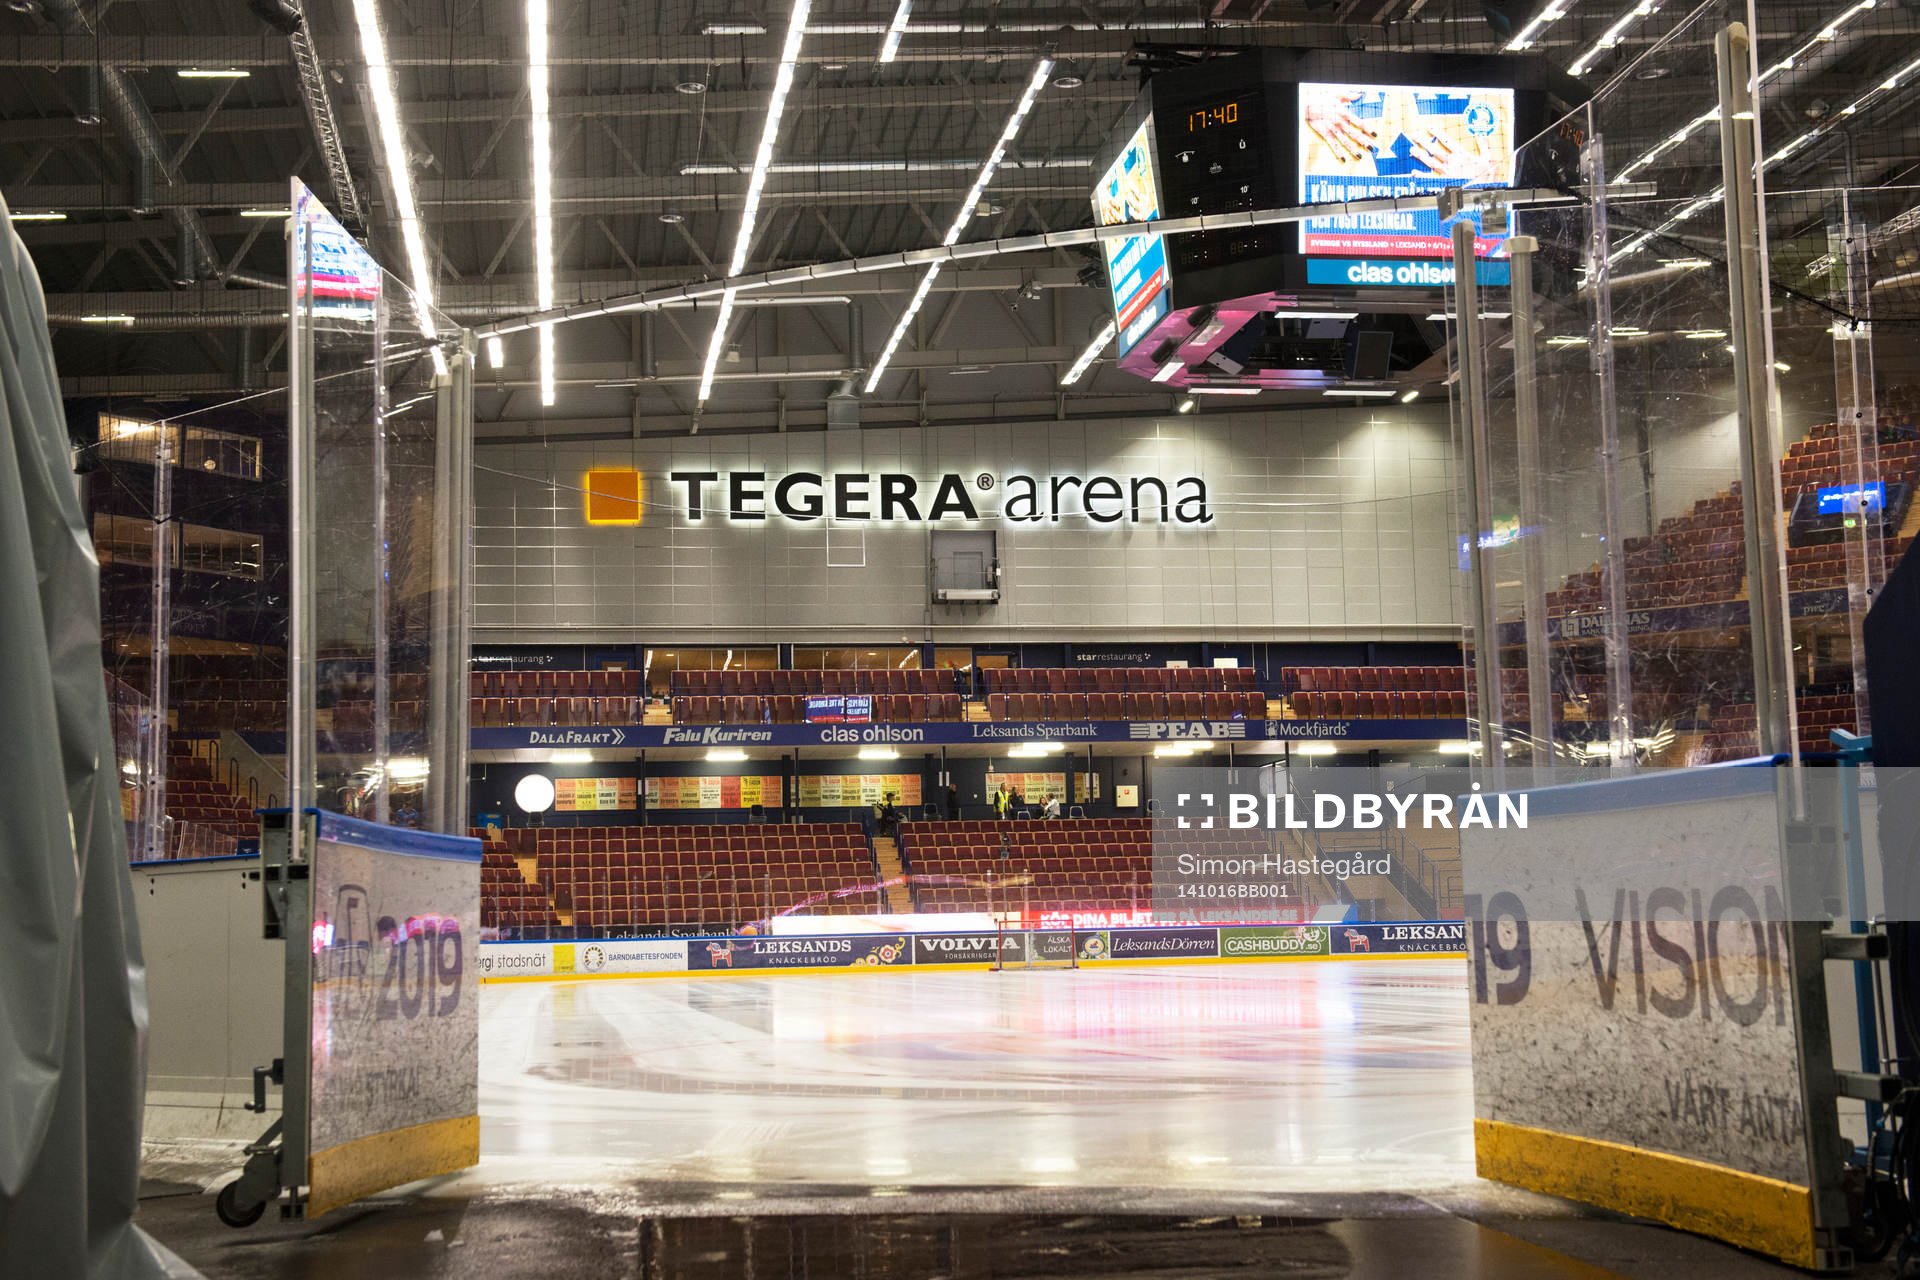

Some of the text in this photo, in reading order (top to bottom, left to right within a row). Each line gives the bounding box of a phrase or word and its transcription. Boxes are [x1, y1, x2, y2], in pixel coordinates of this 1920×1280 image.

[1189, 103, 1238, 132] 17:40
[1311, 181, 1344, 203] KÄNN
[1310, 239, 1341, 248] SVERIGE
[1342, 240, 1353, 248] VS
[1354, 239, 1389, 248] RYSSLAND
[1395, 240, 1427, 250] LEKSAND
[1347, 261, 1393, 283] clas
[1005, 475, 1214, 524] arena
[663, 727, 772, 745] Falu Kuriren
[821, 725, 924, 742] clas ohlson
[973, 724, 1097, 740] Leksands Sparbank
[1147, 722, 1230, 739] PEAB
[1040, 911, 1069, 926] KÖP
[1072, 913, 1107, 926] DINA
[1110, 910, 1177, 924] BILJETTER
[1179, 908, 1197, 922] PÅ
[1382, 925, 1465, 940] LEKSAN
[754, 940, 852, 954] LEKSANDS
[920, 937, 1020, 951] VOLVIA
[1043, 945, 1072, 953] LOKALT
[1400, 943, 1466, 952] KNÄCKEBRÖ
[497, 953, 547, 969] stadsnät
[608, 951, 684, 961] BARNDIABETESFONDEN
[375, 914, 464, 1021] 2019
